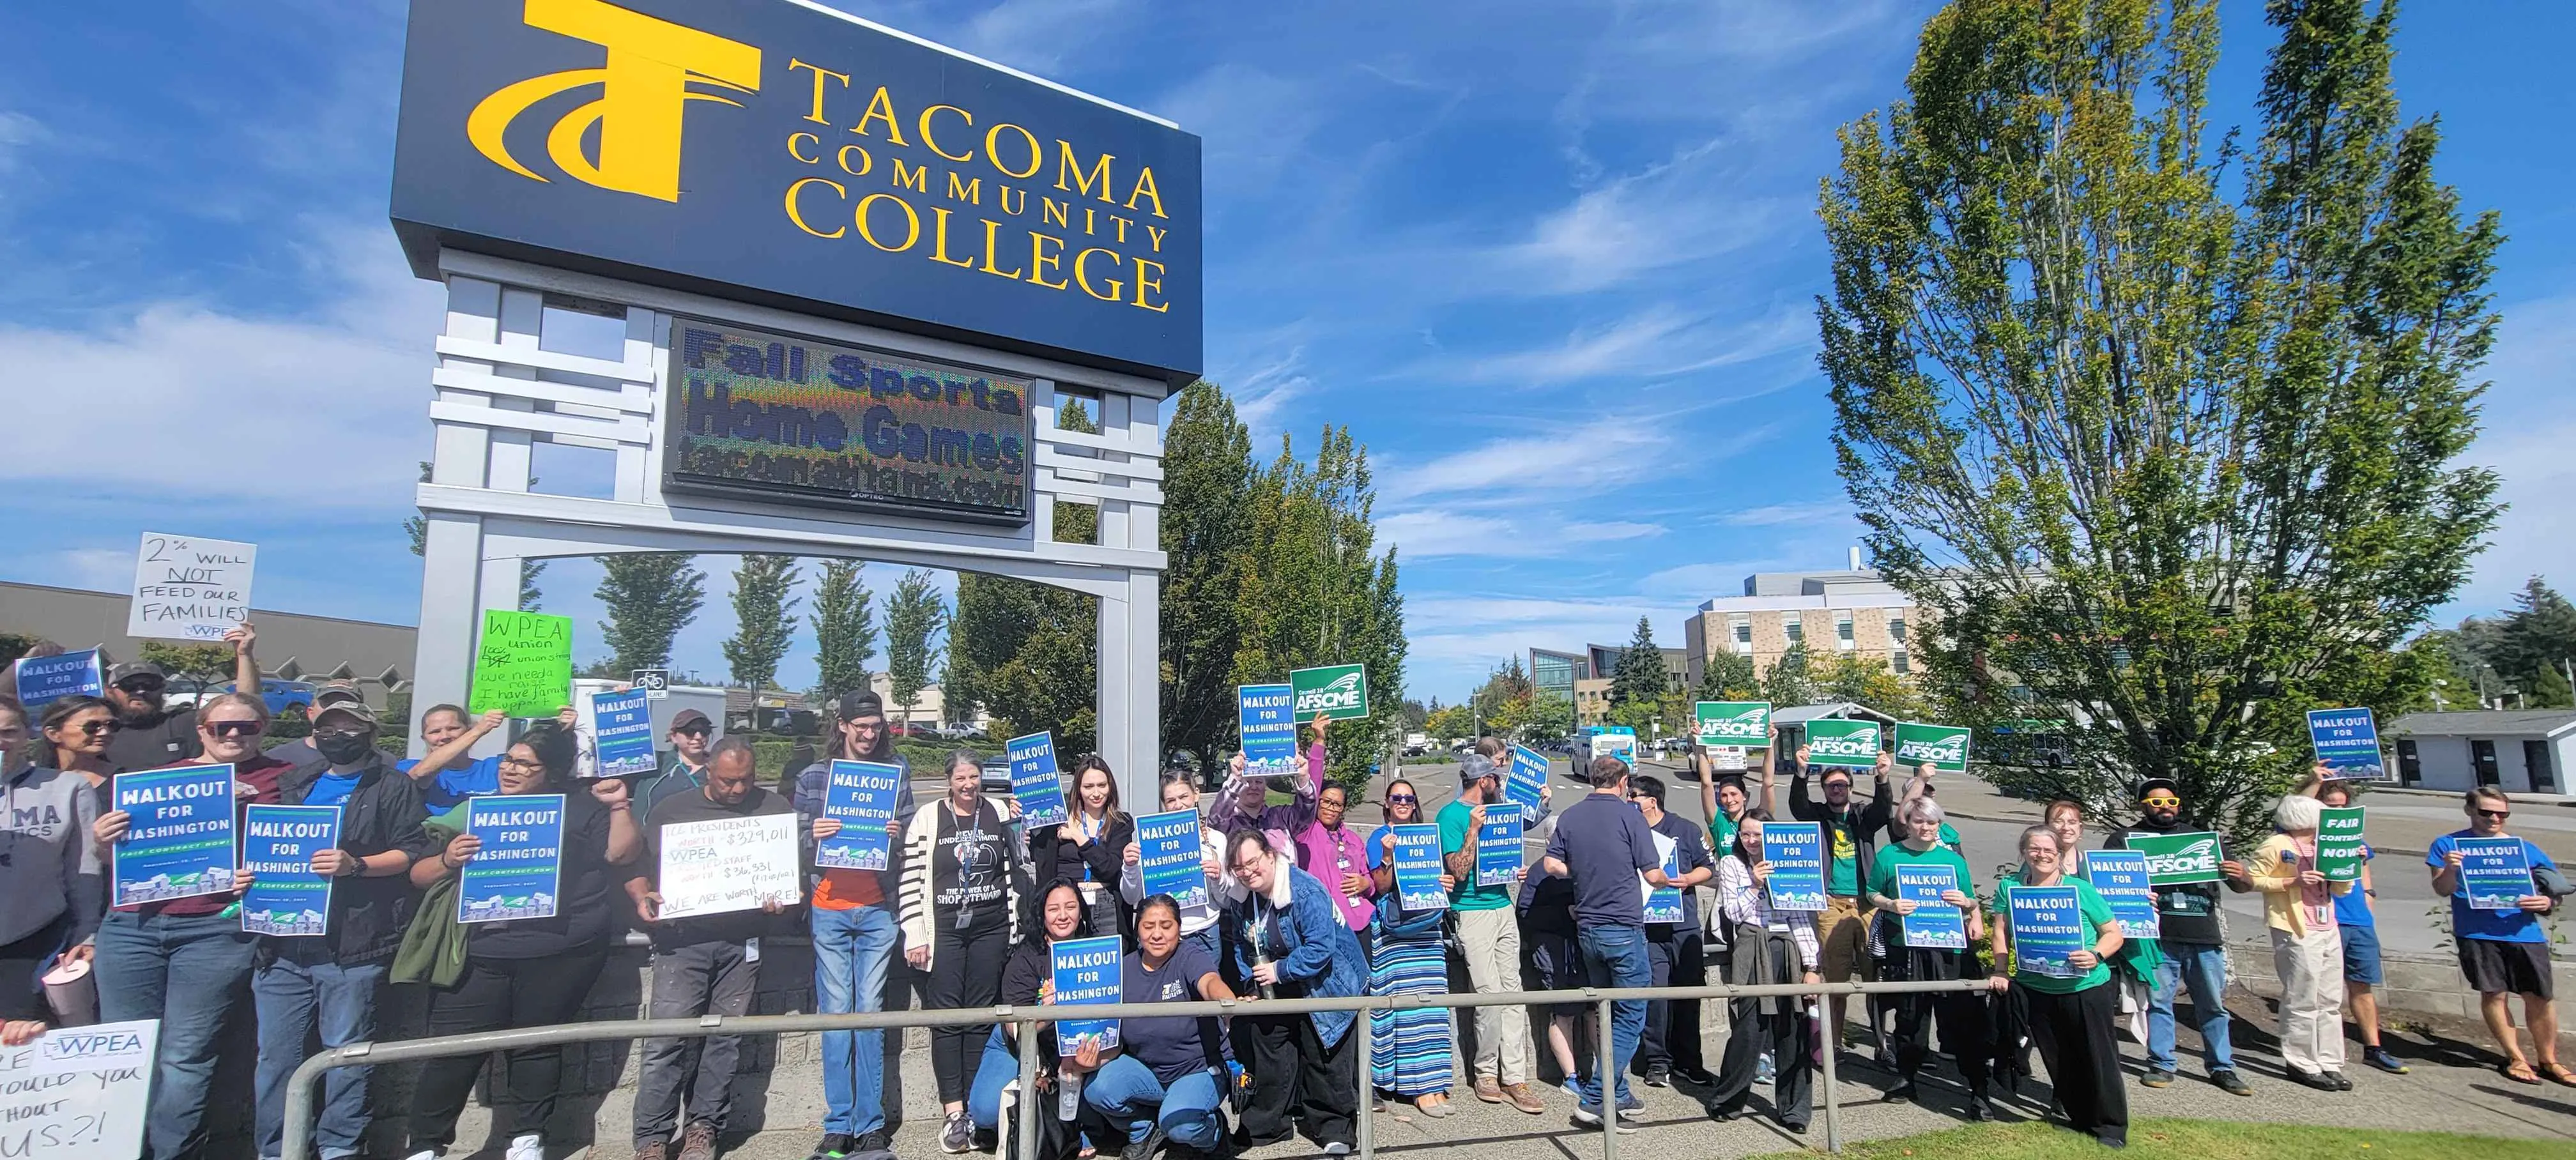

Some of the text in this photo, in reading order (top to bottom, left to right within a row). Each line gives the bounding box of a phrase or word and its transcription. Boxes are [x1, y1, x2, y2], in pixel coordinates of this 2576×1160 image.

[788, 56, 1169, 218] TACOMA
[787, 132, 1167, 253] COMMUNITY
[785, 178, 1170, 314] COLLEGE
[684, 326, 804, 383] Fall
[687, 379, 1022, 475] Home Games
[196, 553, 247, 563] WILL
[167, 567, 224, 582] NOT
[139, 586, 195, 597] FEED
[142, 602, 248, 622] FAMILIES
[192, 624, 231, 637] WPE
[489, 615, 562, 639] WPEA
[22, 660, 94, 676] WALKOUT
[512, 668, 545, 680] need
[47, 675, 72, 685] FOR
[23, 683, 98, 699] WASHINGTON
[479, 689, 491, 699] I
[498, 689, 528, 699] have
[597, 698, 645, 714] WALKOUT
[1243, 696, 1291, 708] WALKOUT
[1296, 691, 1360, 710] AFSCME
[616, 714, 632, 722] FOR
[1260, 710, 1276, 720] FOR
[1243, 722, 1293, 733] WASHINGTON
[1700, 722, 1765, 735] AFSCME
[2313, 717, 2367, 728] WALKOUT
[598, 723, 649, 736] WASHINGTON
[1809, 740, 1877, 755] AFSCME
[2317, 738, 2374, 747] WASHINGTON
[1011, 744, 1049, 763] WALKOUT
[1897, 744, 1963, 760] AFSCME
[1023, 762, 1038, 772] FOR
[1516, 753, 1546, 774] WALKOUT
[1524, 768, 1535, 777] FOR
[834, 774, 895, 791] WALKOUT
[1013, 772, 1057, 788] WASHINGTON
[1510, 772, 1542, 790] WASHINGTO
[122, 781, 226, 805] WALKOUT
[852, 791, 873, 802] FOR
[157, 805, 193, 820] FOR
[828, 805, 892, 819] WASHINGTON
[475, 811, 557, 827] WALKOUT
[2326, 818, 2359, 828] FAIR
[250, 821, 332, 838] WALKOUT
[727, 826, 788, 846] $329,011
[956, 829, 985, 837] NEVR
[1141, 821, 1195, 841] WALKOUT
[1493, 827, 1507, 835] FOR
[500, 831, 528, 843] FOR
[1480, 837, 1521, 847] WASHINGTON
[1767, 833, 1817, 844] WALKOUT
[271, 843, 299, 855] FOR
[1161, 840, 1179, 851] FOR
[1784, 848, 1801, 856] FOR
[2460, 846, 2519, 856] WALKOUT
[670, 848, 717, 861] WPEA
[723, 854, 752, 864] STAFF
[1143, 850, 1200, 867] WASHINGTON
[246, 861, 318, 873] WASHINGTO
[1397, 860, 1441, 869] WASHINGTON
[2092, 861, 2143, 872] WALKOUT
[2145, 855, 2216, 873] AFSCME
[1901, 874, 1952, 885] WALKOUT
[2113, 875, 2131, 883] FOR
[937, 889, 1002, 904] SHOP TEWARD
[2096, 887, 2149, 896] WASHINGTON
[664, 887, 797, 913] WE ARE WORTH MORE!
[2014, 897, 2074, 909] WALKOUT
[2016, 924, 2080, 934] WASHINGTON
[1057, 950, 1117, 970] WALKOUT
[1077, 971, 1099, 984] FOR
[1057, 985, 1119, 1002] WASHINGTON
[59, 1034, 142, 1054] WPEA
[0, 1067, 142, 1094] OULD YOU
[1, 1111, 106, 1157] US?!
